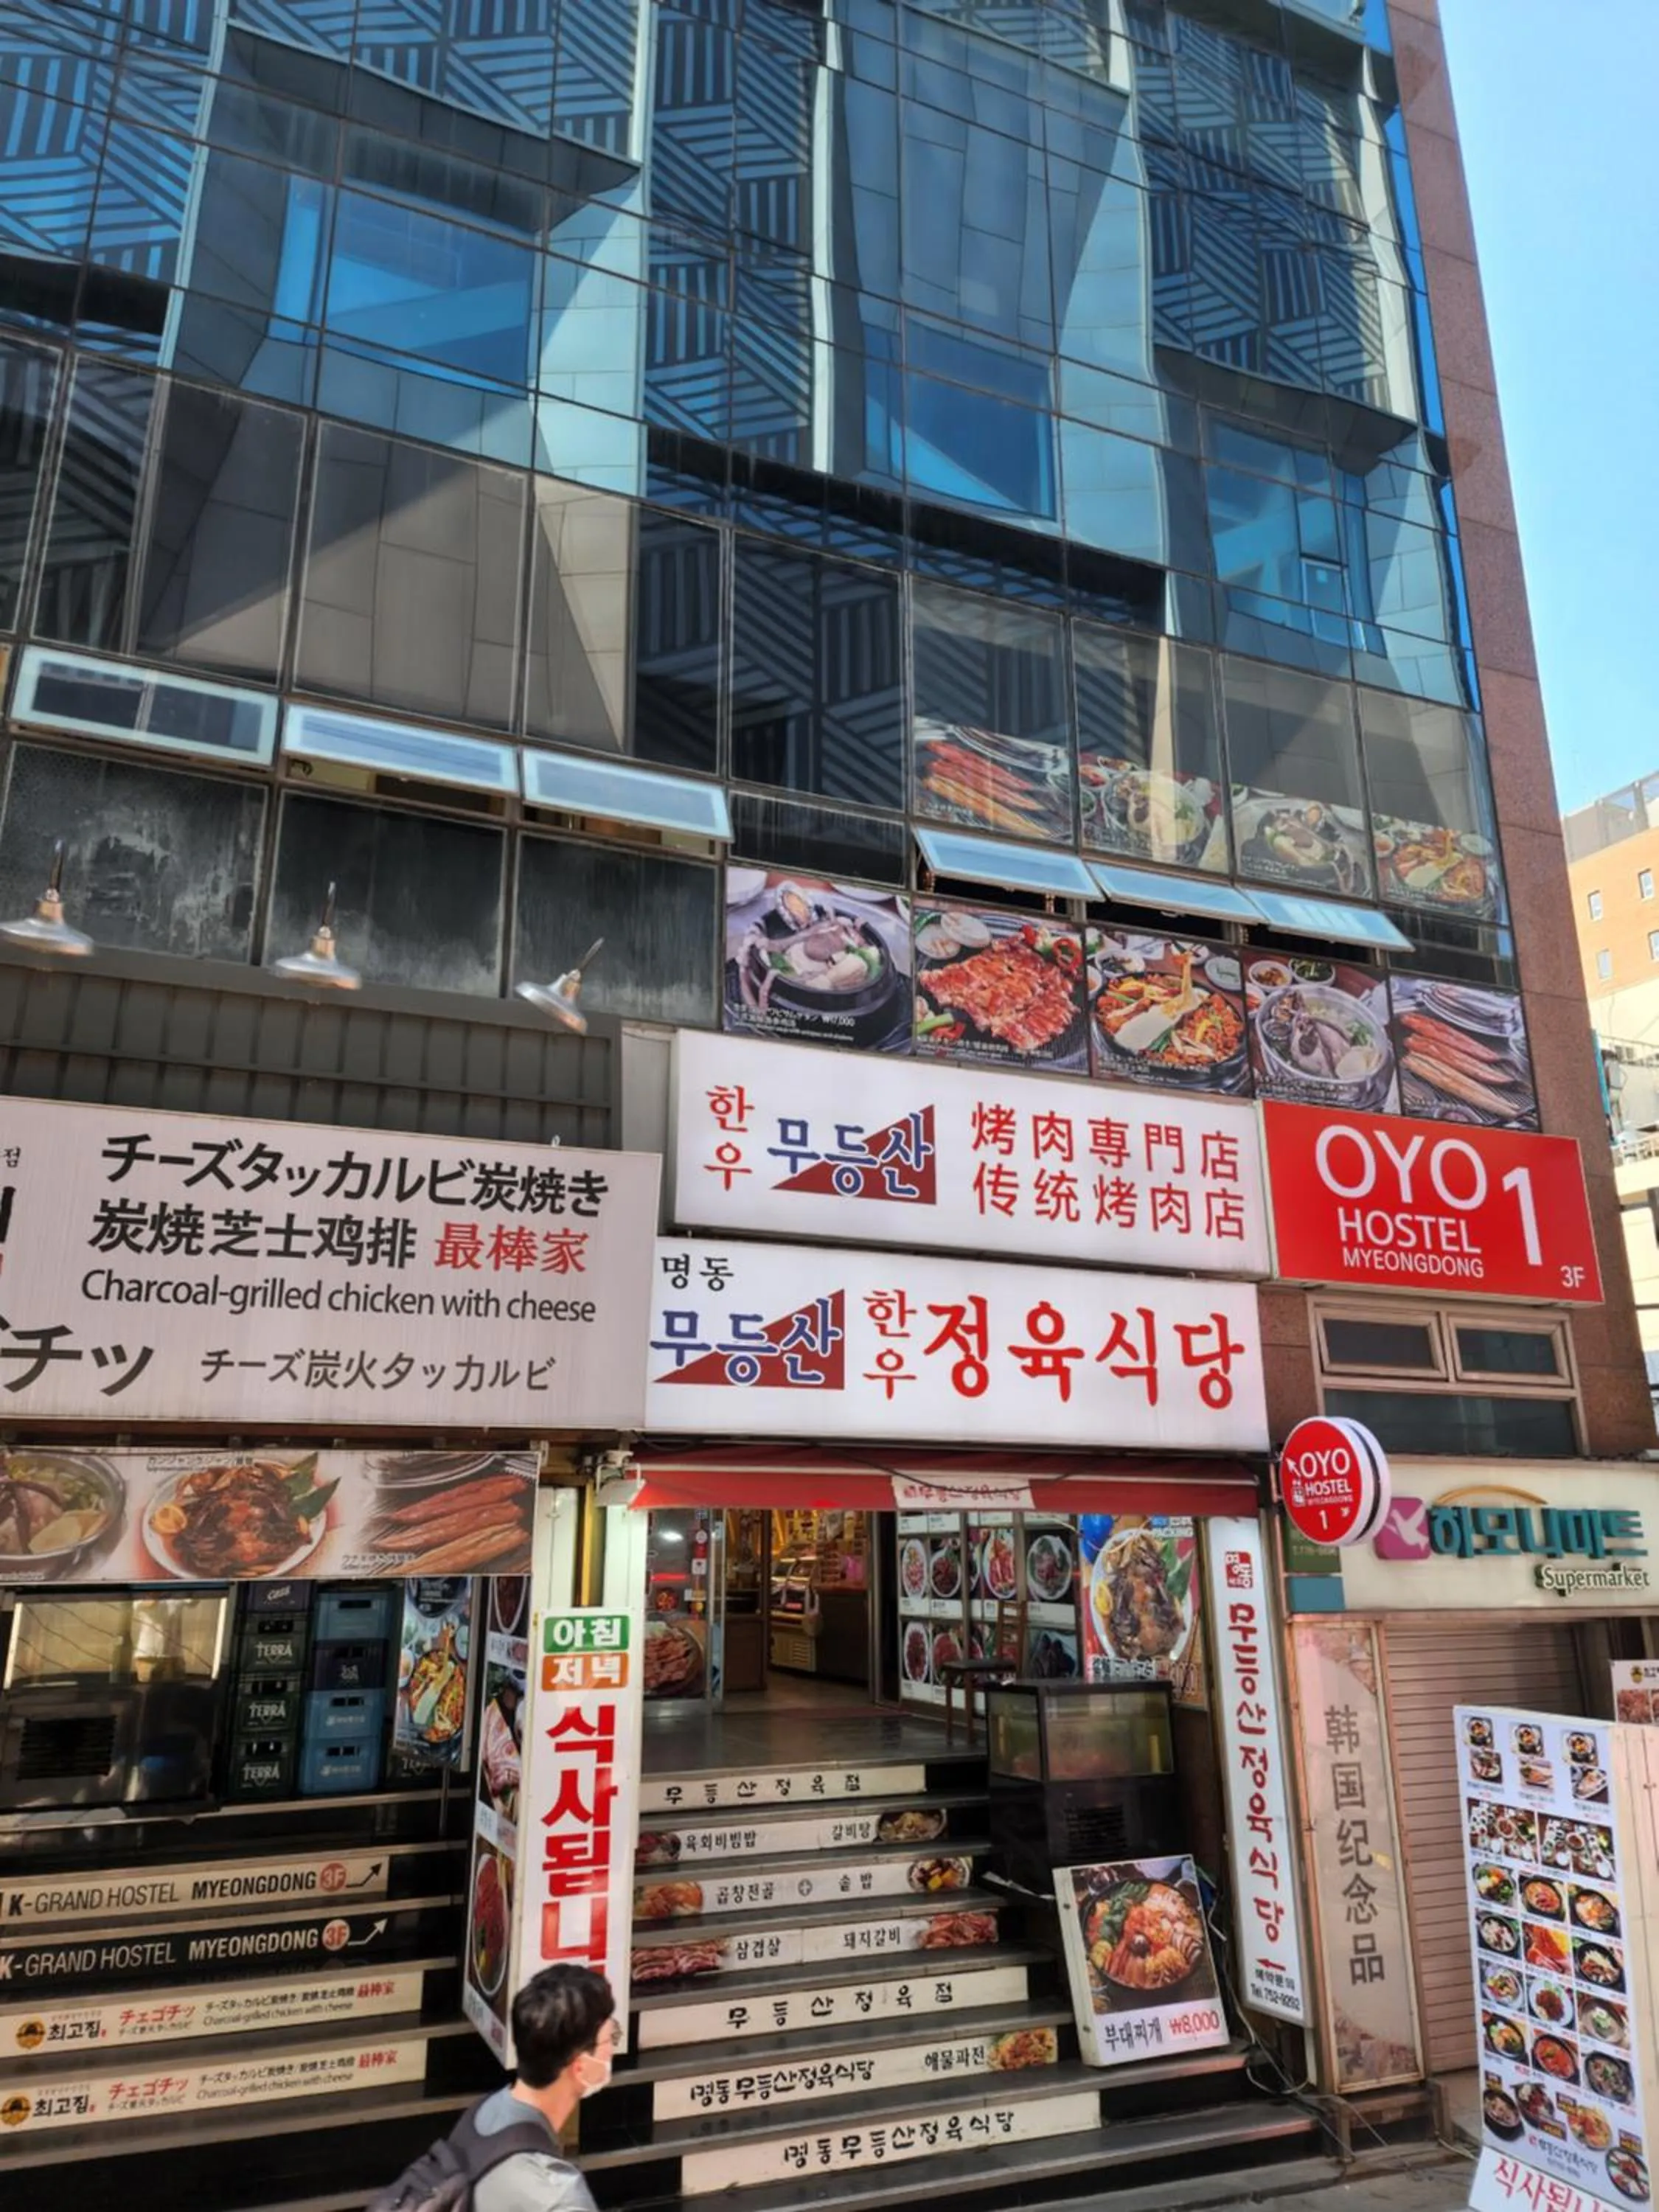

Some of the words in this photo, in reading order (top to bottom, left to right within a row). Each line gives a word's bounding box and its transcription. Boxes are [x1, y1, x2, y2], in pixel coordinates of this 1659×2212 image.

[704, 1085, 754, 1190] 한우
[768, 1112, 933, 1197] 무등산
[101, 1134, 608, 1218] チーズタッカルビ炭焼き
[973, 1161, 1245, 1242] 传统烤肉店
[1315, 1125, 1487, 1211] OYO
[1503, 1166, 1543, 1266] 1
[434, 1222, 590, 1273] 最棒家
[1338, 1207, 1482, 1253] HOSTEL
[661, 1253, 734, 1292] 명동
[1343, 1248, 1484, 1279] MYEONGDONG
[1561, 1266, 1585, 1287] 3F
[82, 1269, 321, 1314] Charcoal-grilled
[328, 1283, 435, 1315] chicken
[441, 1290, 502, 1319] with
[507, 1296, 597, 1323] cheese
[0, 1315, 156, 1396] チッ
[649, 1298, 844, 1386] 무등산
[863, 1290, 917, 1400] 한우
[924, 1295, 1245, 1411] 정육식당
[201, 1349, 557, 1392] チーズ炭火タッカルビ
[1300, 1448, 1350, 1478] OYO
[1304, 1478, 1352, 1496] HOSTEL
[1319, 1509, 1328, 1530] 1
[1427, 1506, 1648, 1558] 하모니마트
[1543, 1565, 1651, 1596] Supermarket
[255, 1639, 293, 1658] TERRA
[552, 1618, 622, 1649] 아침
[551, 1654, 621, 1687] 저녁
[249, 1700, 286, 1719] TERRA
[665, 1773, 861, 1804] 무등산정육점
[1228, 1601, 1285, 1943] 무등산정육식당
[540, 1705, 619, 1976] 식사됩니
[832, 1821, 871, 1840] 갈비탕
[1324, 1705, 1385, 1986] 韩国纪念品
[8, 1888, 103, 1916] K-GRAND
[107, 1882, 180, 1907] HOSTEL
[192, 1871, 317, 1900] MYEONGDONG
[322, 1868, 347, 1888] 3F
[0, 1949, 97, 1980] K-GRAND
[100, 1942, 176, 1970] HOSTEL
[189, 1929, 319, 1961] MYEONGDONG
[326, 1926, 347, 1944] 3F
[737, 1937, 781, 1960] 삼겹살
[844, 1926, 901, 1950] 돼지갈비
[120, 2004, 196, 2025] チェゴチッ
[271, 2006, 303, 2020] chicken
[305, 2003, 324, 2014] with
[324, 2002, 353, 2012] cheese
[727, 1981, 953, 2029] 무등산정육점
[47, 2020, 101, 2042] 최고집
[1105, 2017, 1163, 2052] 부대찌개
[1169, 2010, 1220, 2037] ₩8,000
[108, 2076, 189, 2100] チェゴチッ
[268, 2078, 302, 2091] chicken
[302, 2074, 322, 2087] with
[323, 2072, 354, 2084] cheese
[32, 2095, 89, 2118] 최고집
